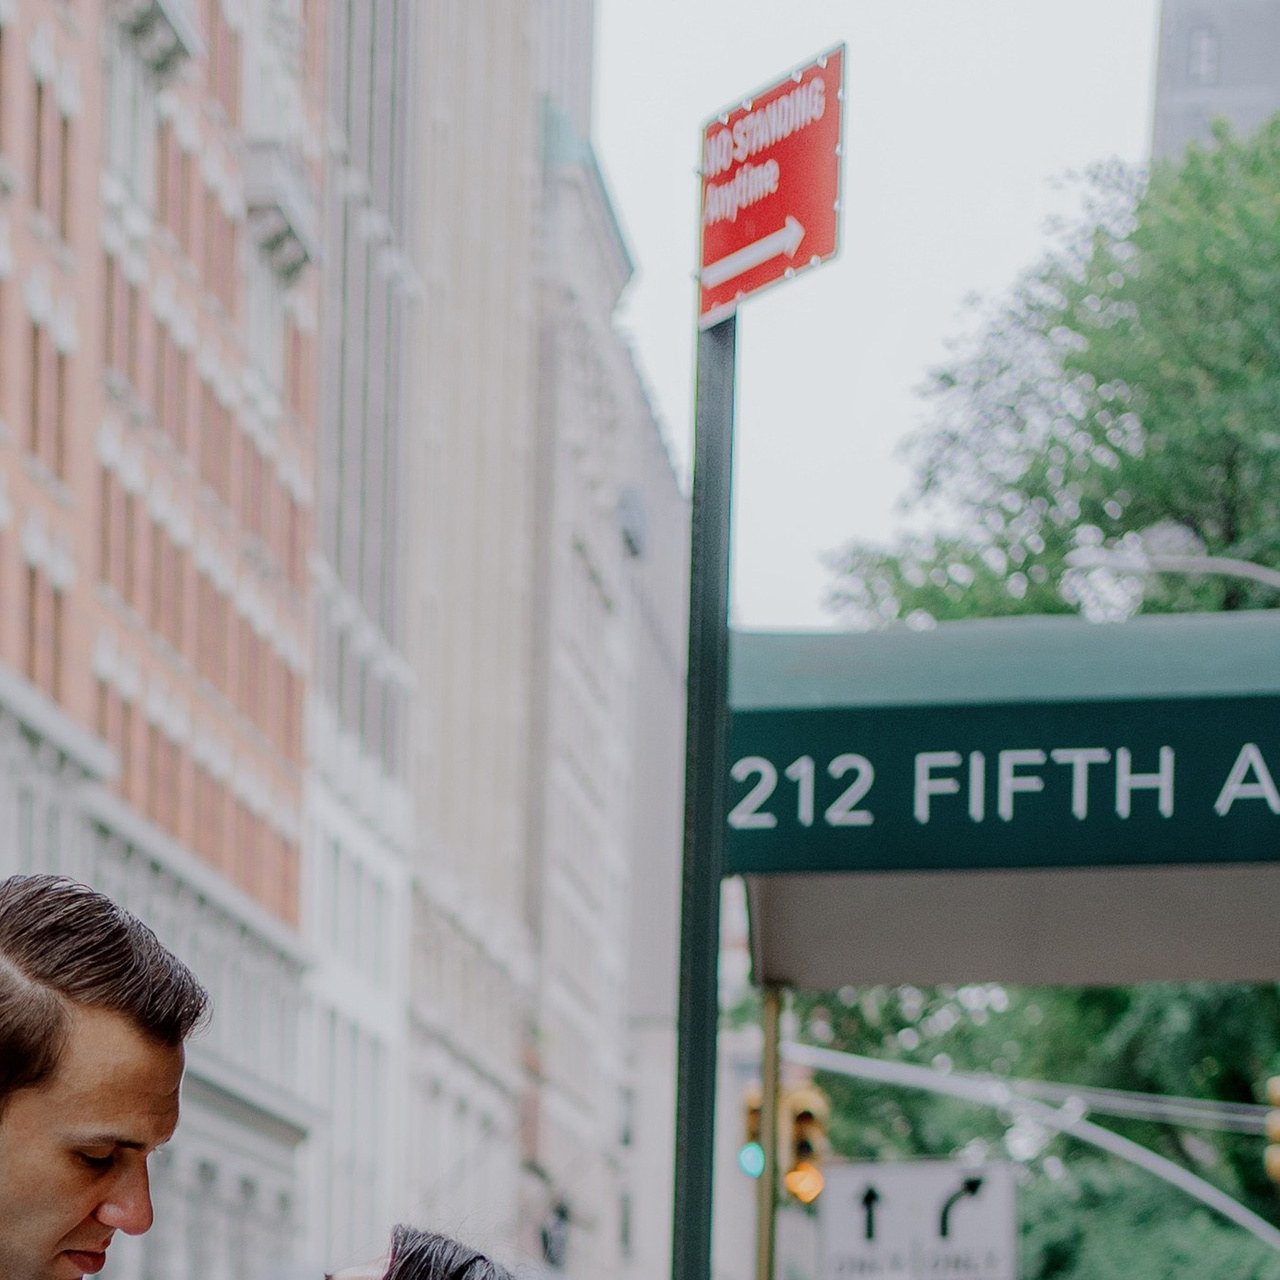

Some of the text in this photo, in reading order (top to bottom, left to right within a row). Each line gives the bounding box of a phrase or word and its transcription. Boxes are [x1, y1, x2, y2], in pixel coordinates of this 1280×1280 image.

[705, 77, 825, 178] NO STANDING
[705, 159, 780, 225] Anytime
[727, 753, 875, 829] 212
[913, 746, 1175, 824] FIFTH
